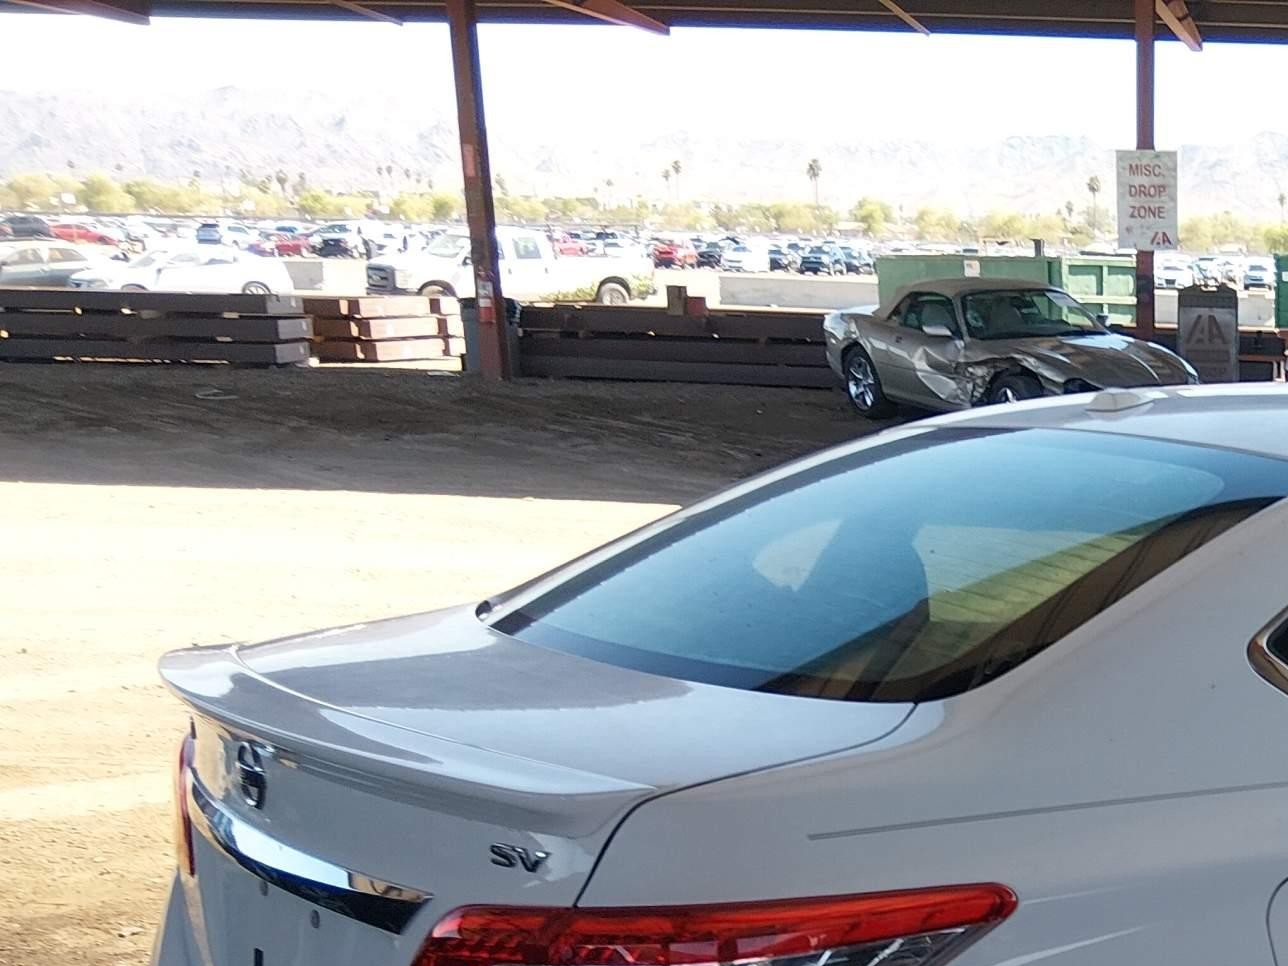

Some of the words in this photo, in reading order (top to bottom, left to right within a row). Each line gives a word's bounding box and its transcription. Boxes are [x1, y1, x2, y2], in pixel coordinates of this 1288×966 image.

[1128, 163, 1166, 177] MISC.
[1128, 183, 1167, 198] DROP
[1128, 205, 1166, 219] ZONE
[490, 842, 552, 873] SV
